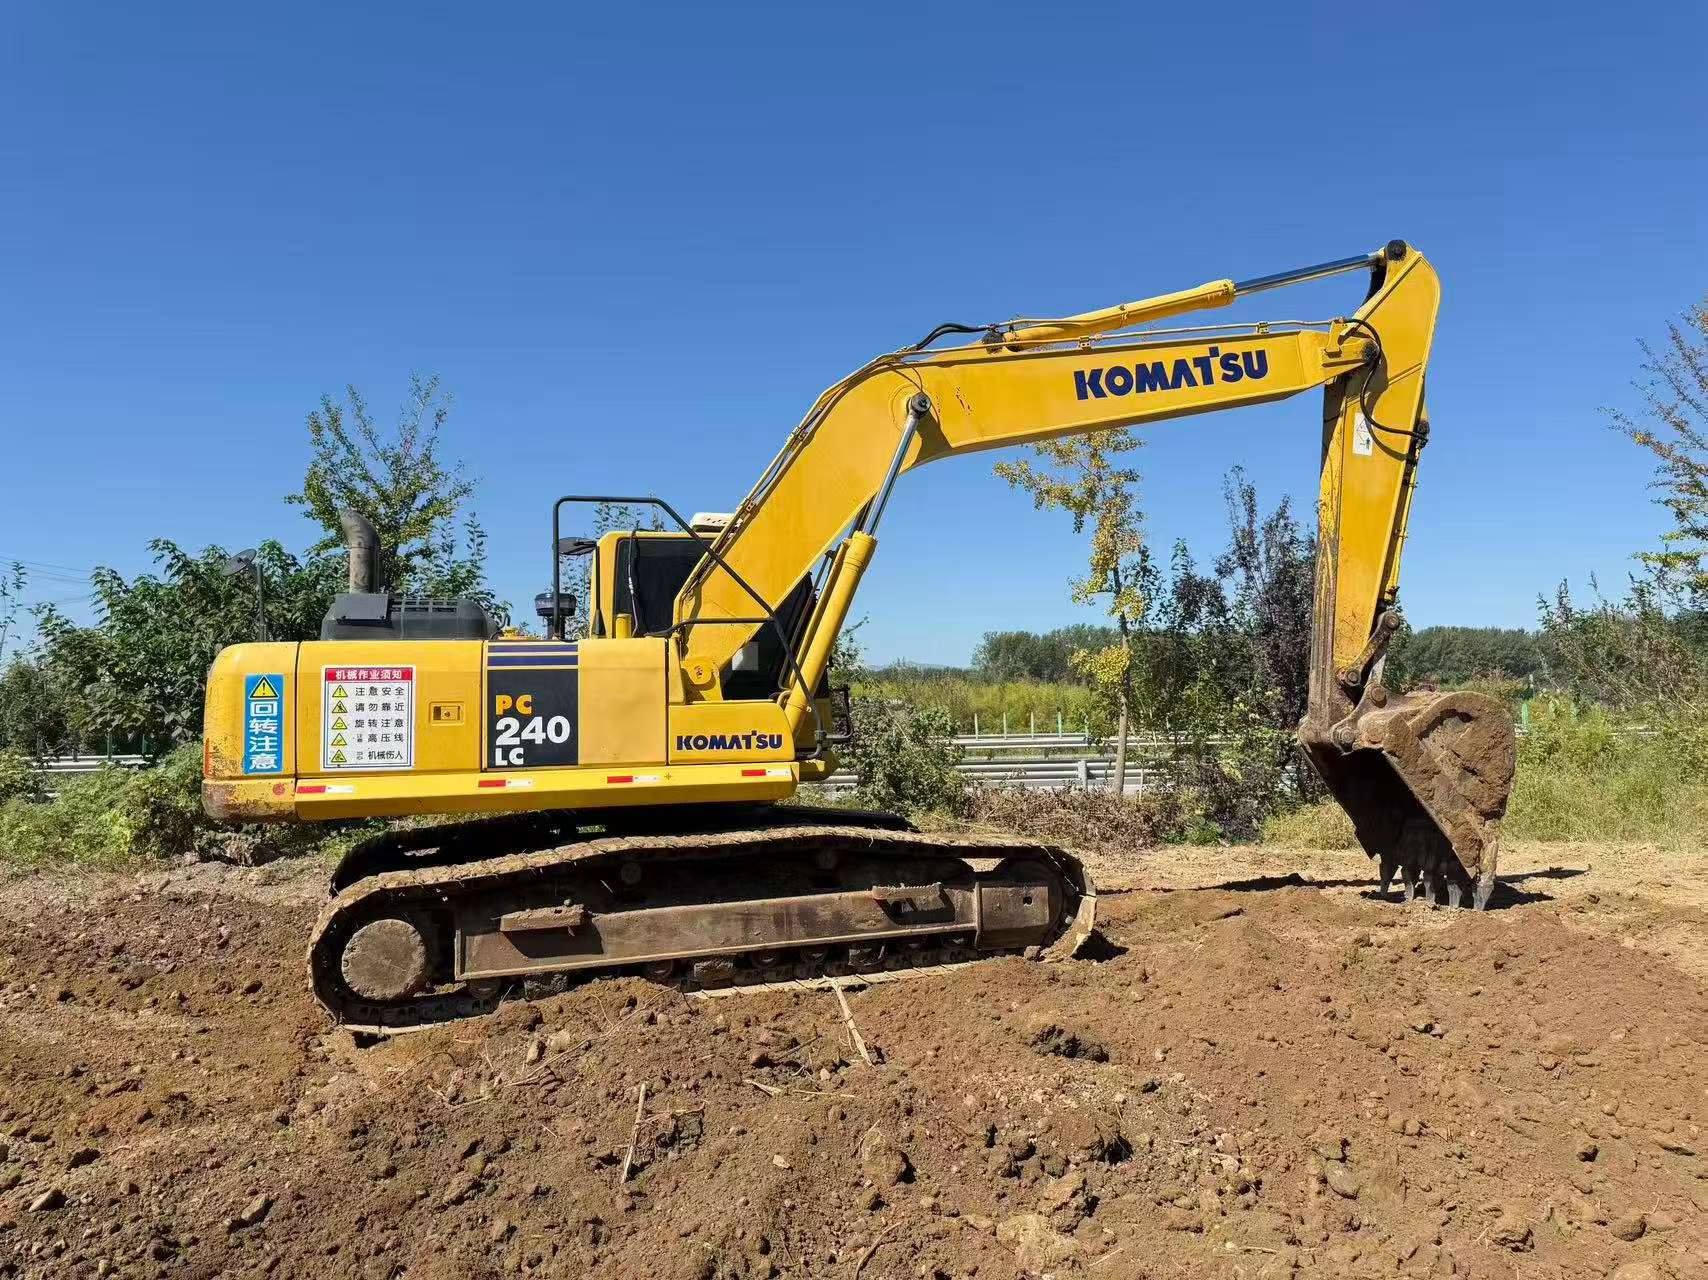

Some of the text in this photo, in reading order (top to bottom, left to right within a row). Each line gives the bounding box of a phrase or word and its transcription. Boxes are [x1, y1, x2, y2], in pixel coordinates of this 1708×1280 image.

[1073, 346, 1269, 401] KOMATSU
[336, 669, 402, 680] 机械作业须知
[355, 686, 404, 696] 注意安全
[355, 702, 404, 712] 请勿靠近
[495, 694, 533, 716] PC
[354, 718, 404, 728] 旋转注意
[495, 715, 571, 746] 240
[249, 700, 279, 770] 回转注意
[676, 730, 783, 751] KOMATSU
[494, 747, 525, 766] LC
